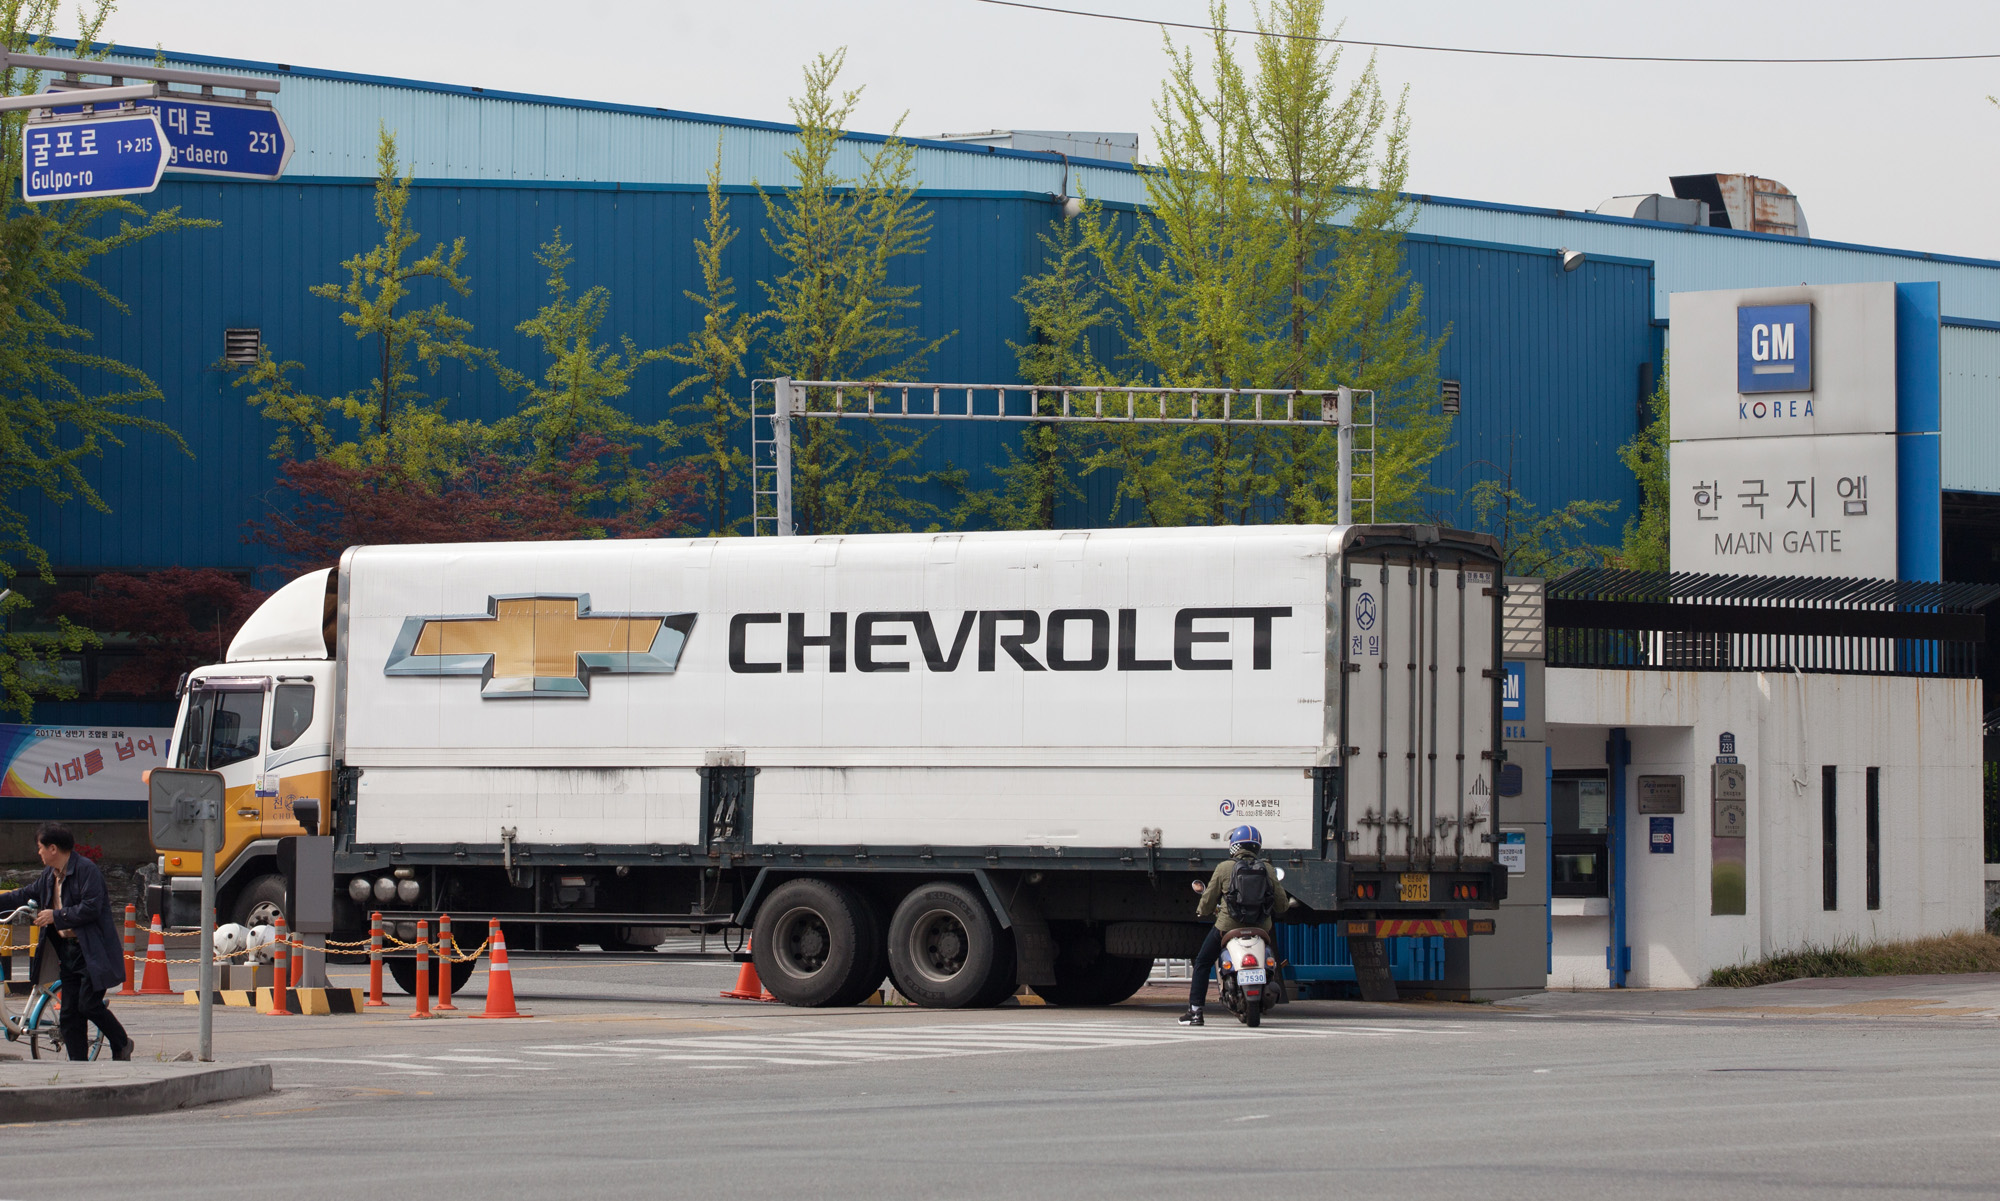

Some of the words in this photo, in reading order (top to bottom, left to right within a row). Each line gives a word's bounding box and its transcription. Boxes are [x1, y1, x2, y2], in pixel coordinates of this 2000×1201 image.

[151, 105, 214, 136] 대로
[31, 129, 98, 167] 굴포로
[135, 137, 152, 152] 215
[249, 131, 277, 154] 231
[170, 144, 228, 165] g-daero
[31, 170, 93, 191] Gulpo-ro
[1751, 322, 1795, 361] GM
[1739, 400, 1814, 419] KOREA
[1692, 475, 1868, 521] 한국지엠
[1714, 531, 1772, 555] MAIN
[1782, 530, 1842, 553] GATE
[728, 606, 1292, 673] CHEVROLET
[35, 729, 62, 738] 2017년
[65, 730, 85, 738] 상반기
[88, 730, 108, 738] 조합원
[1503, 726, 1525, 738] REA
[1722, 743, 1732, 752] 233
[43, 748, 104, 787] 시대를
[115, 735, 157, 761] 넘어
[1407, 884, 1427, 898] 8713
